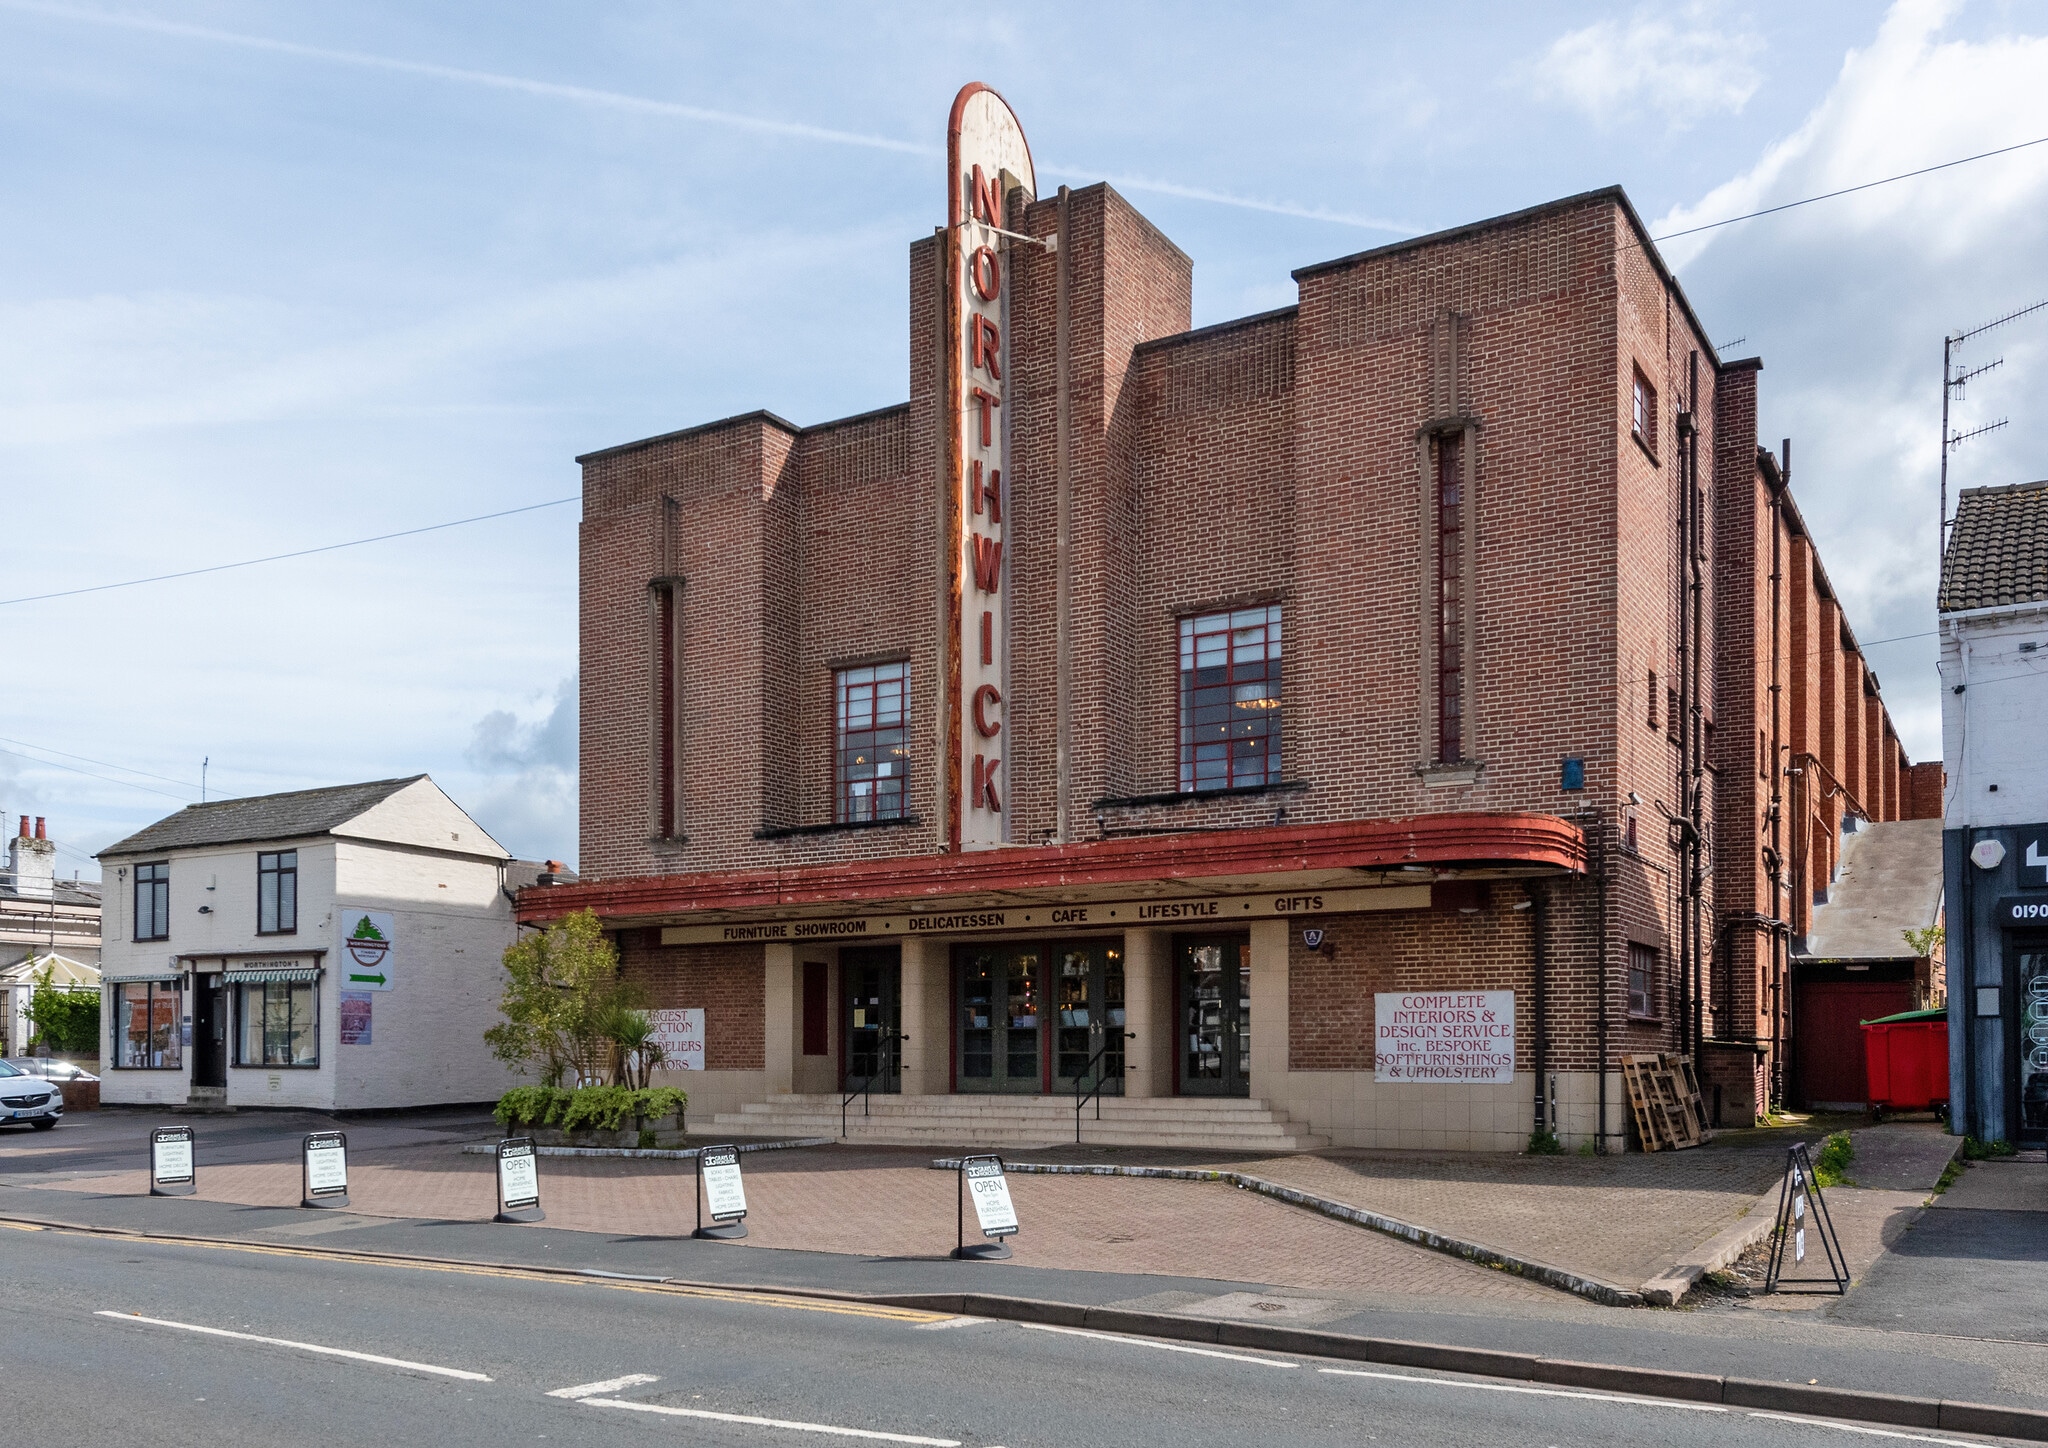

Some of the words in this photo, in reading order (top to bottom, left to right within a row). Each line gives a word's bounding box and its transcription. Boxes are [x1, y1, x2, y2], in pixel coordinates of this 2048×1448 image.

[972, 163, 1002, 813] NORTHWICK
[1139, 901, 1219, 919] LIFESTYLE
[1274, 896, 1324, 912] GIFTS
[2012, 904, 2048, 918] 0190
[908, 913, 1005, 931] DELICATESSEN
[1051, 908, 1088, 922] CAFE
[724, 926, 787, 940] FURNITURE
[795, 921, 867, 936] SHOWROOM
[244, 960, 299, 969] WORTHINGTON'S
[1402, 995, 1486, 1009] COMPLETE
[1393, 1010, 1476, 1024] INTERIORS
[1481, 1009, 1496, 1023] &
[652, 1021, 693, 1033] ECTION
[1380, 1026, 1437, 1038] DESIGN
[1442, 1024, 1511, 1038] SERVICE
[1397, 1040, 1420, 1051] inc.
[1426, 1040, 1492, 1051] BESPOKE
[1389, 1066, 1402, 1077] &
[1406, 1066, 1499, 1079] UPHOLSTERY
[506, 1159, 531, 1170] OPEN
[974, 1179, 1003, 1193] OPEN
